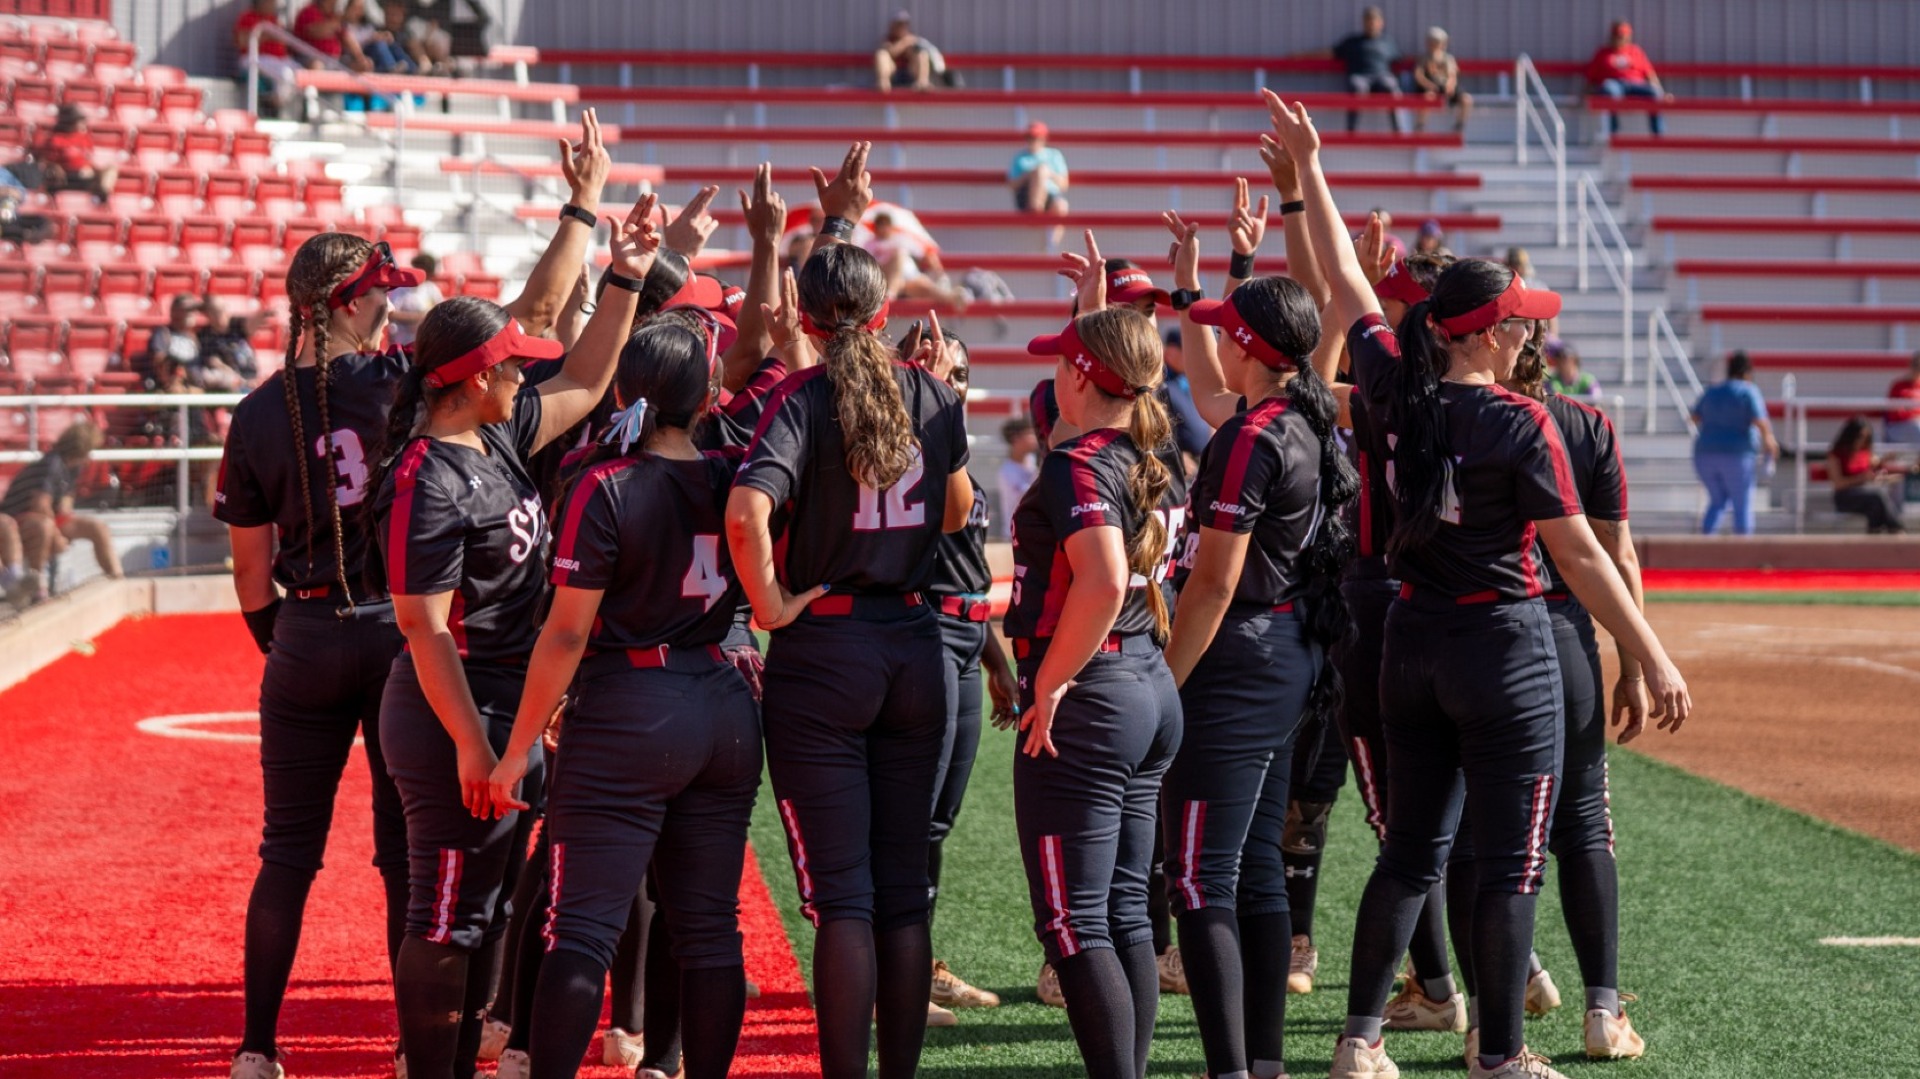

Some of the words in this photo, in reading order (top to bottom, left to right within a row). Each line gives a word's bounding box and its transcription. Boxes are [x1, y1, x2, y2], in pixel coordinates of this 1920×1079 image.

[315, 427, 369, 507] 3
[853, 443, 925, 529] 12
[681, 534, 728, 614] 4
[1176, 532, 1201, 569] 8
